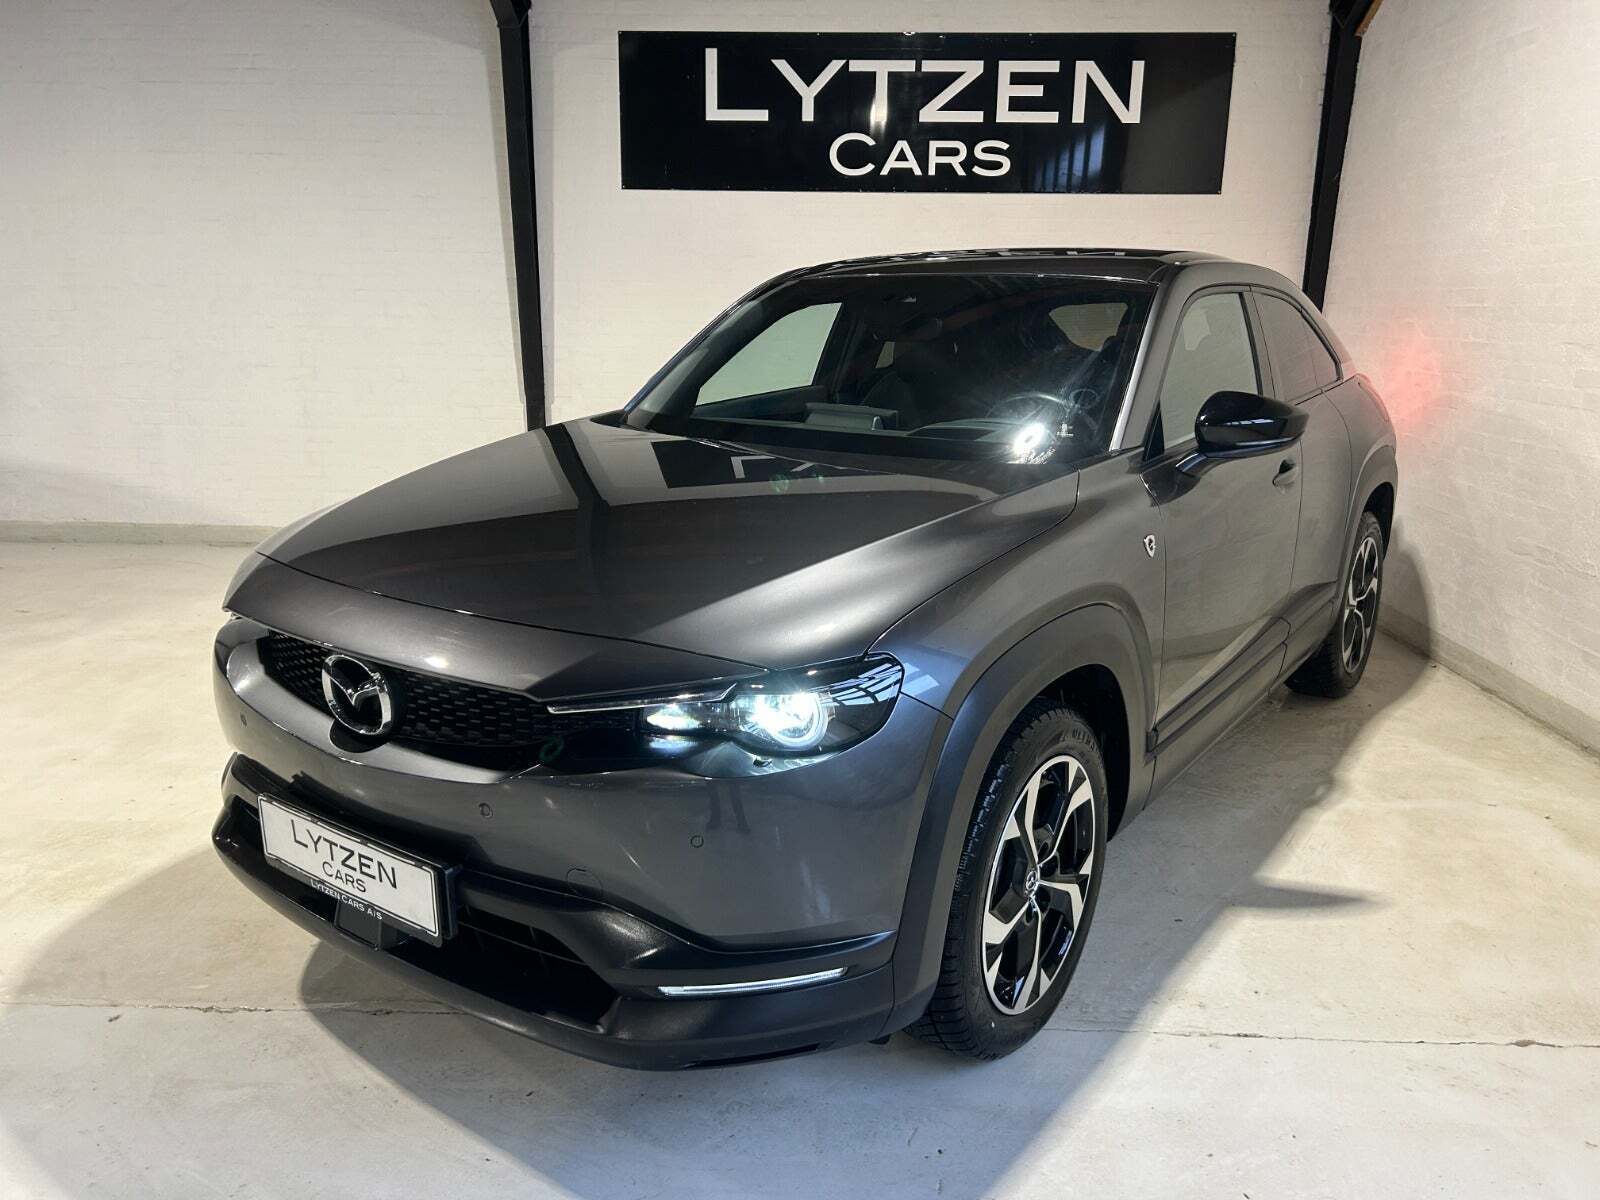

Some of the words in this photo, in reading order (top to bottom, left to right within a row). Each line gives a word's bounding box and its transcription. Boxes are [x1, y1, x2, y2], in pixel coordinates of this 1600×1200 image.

[705, 47, 1145, 124] LYTZEN
[829, 132, 1011, 177] CARS
[291, 819, 398, 890] LYTZEN
[322, 861, 367, 893] CARS
[310, 879, 340, 900] LYTZEN
[341, 895, 365, 912] CARS
